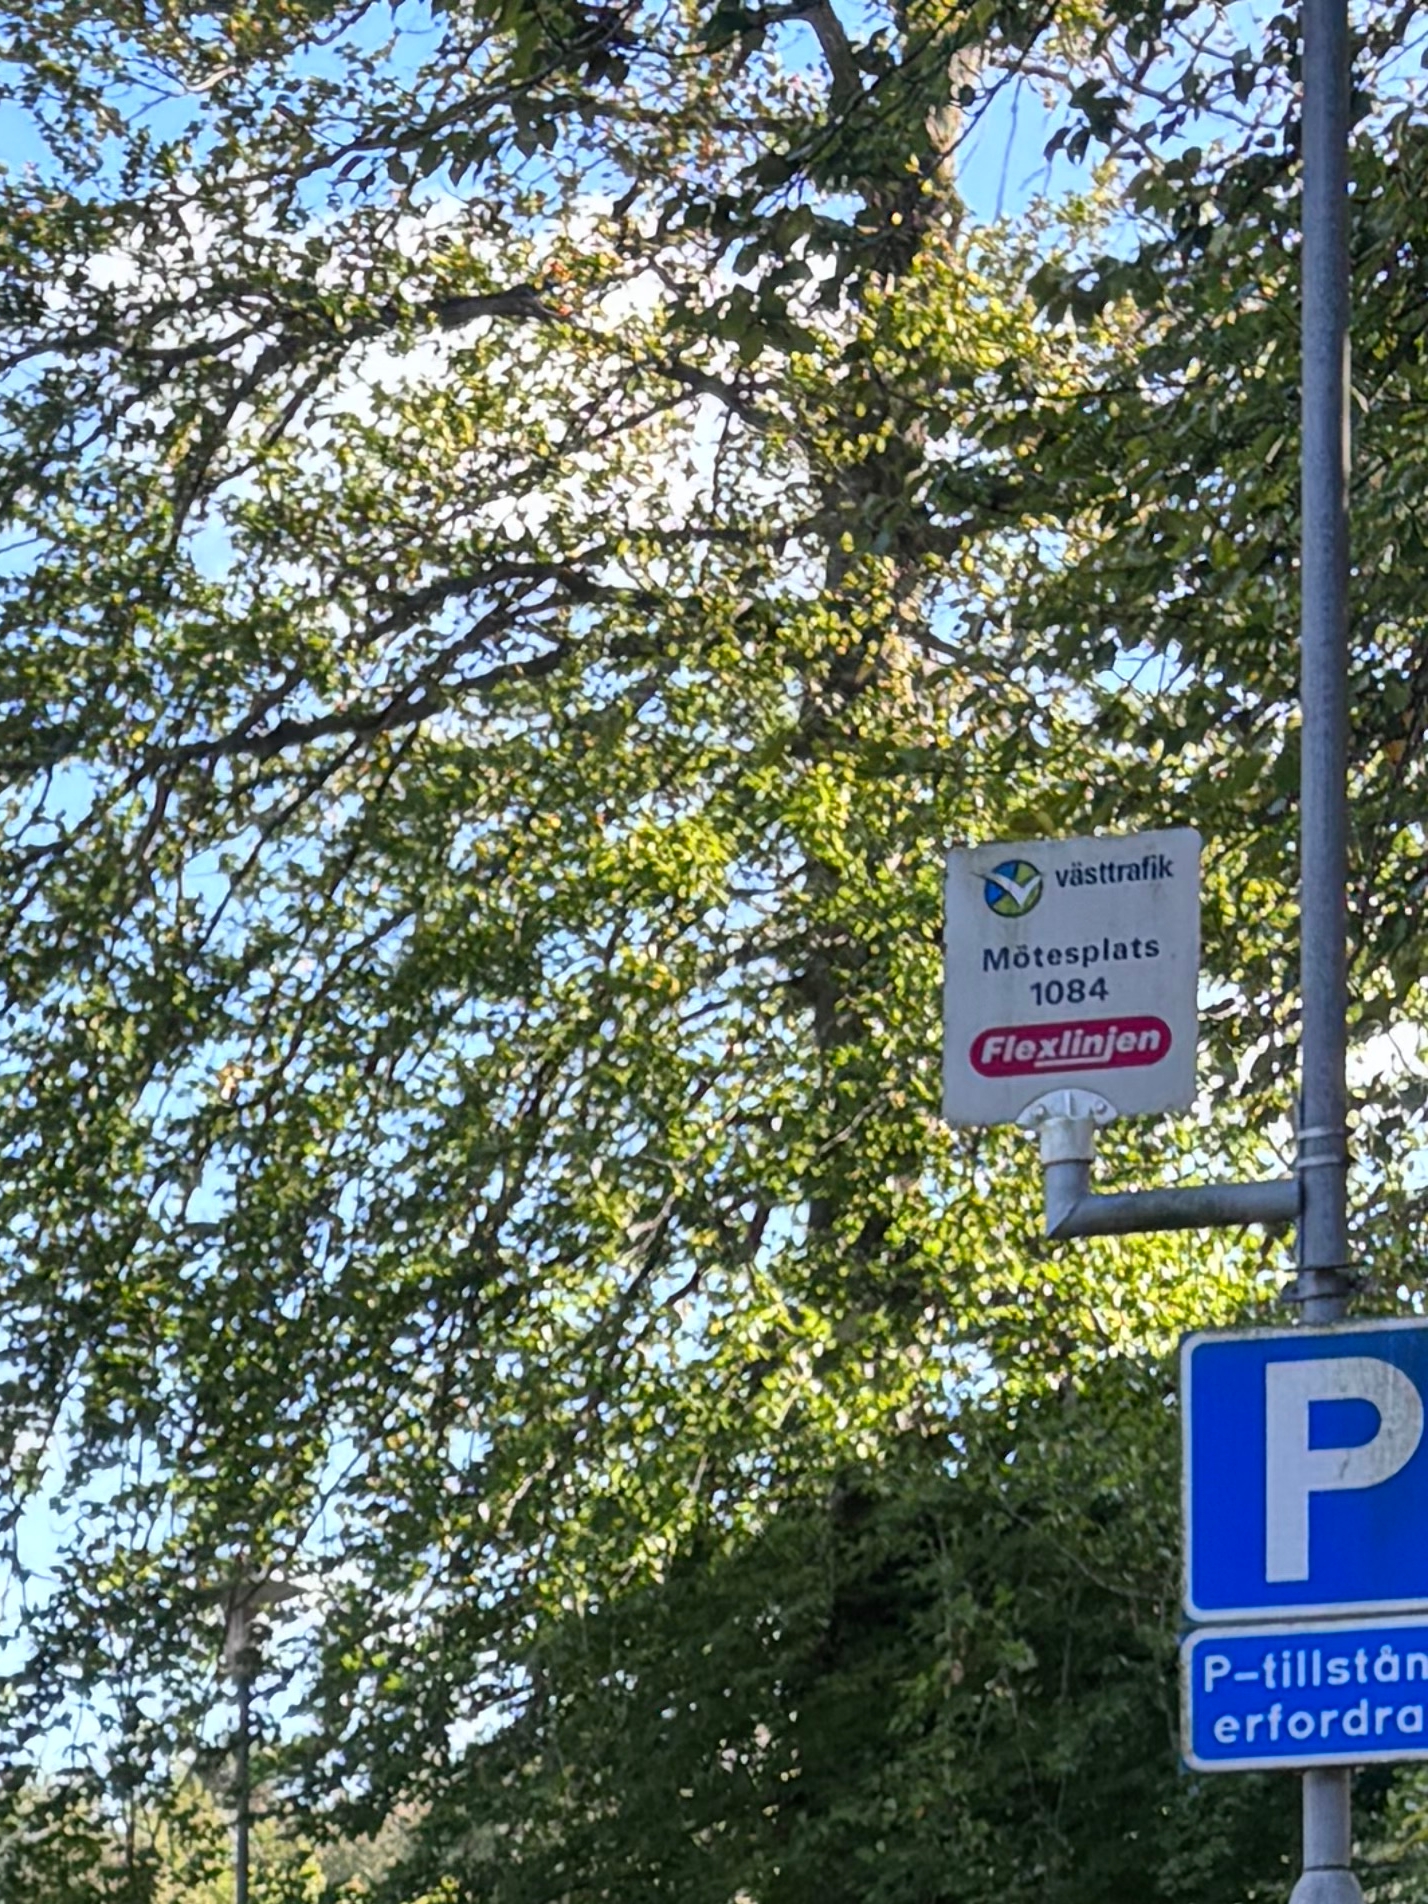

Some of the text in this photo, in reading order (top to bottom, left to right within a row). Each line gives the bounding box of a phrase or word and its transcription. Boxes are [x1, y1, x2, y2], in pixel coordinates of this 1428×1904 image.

[1055, 854, 1173, 889] västtrafik
[982, 937, 1161, 972] Mötesplats
[1030, 976, 1109, 1006] 1084
[981, 1022, 1161, 1066] Flexlinjen
[1265, 1356, 1424, 1582] P
[1213, 1698, 1423, 1744] erfordra
